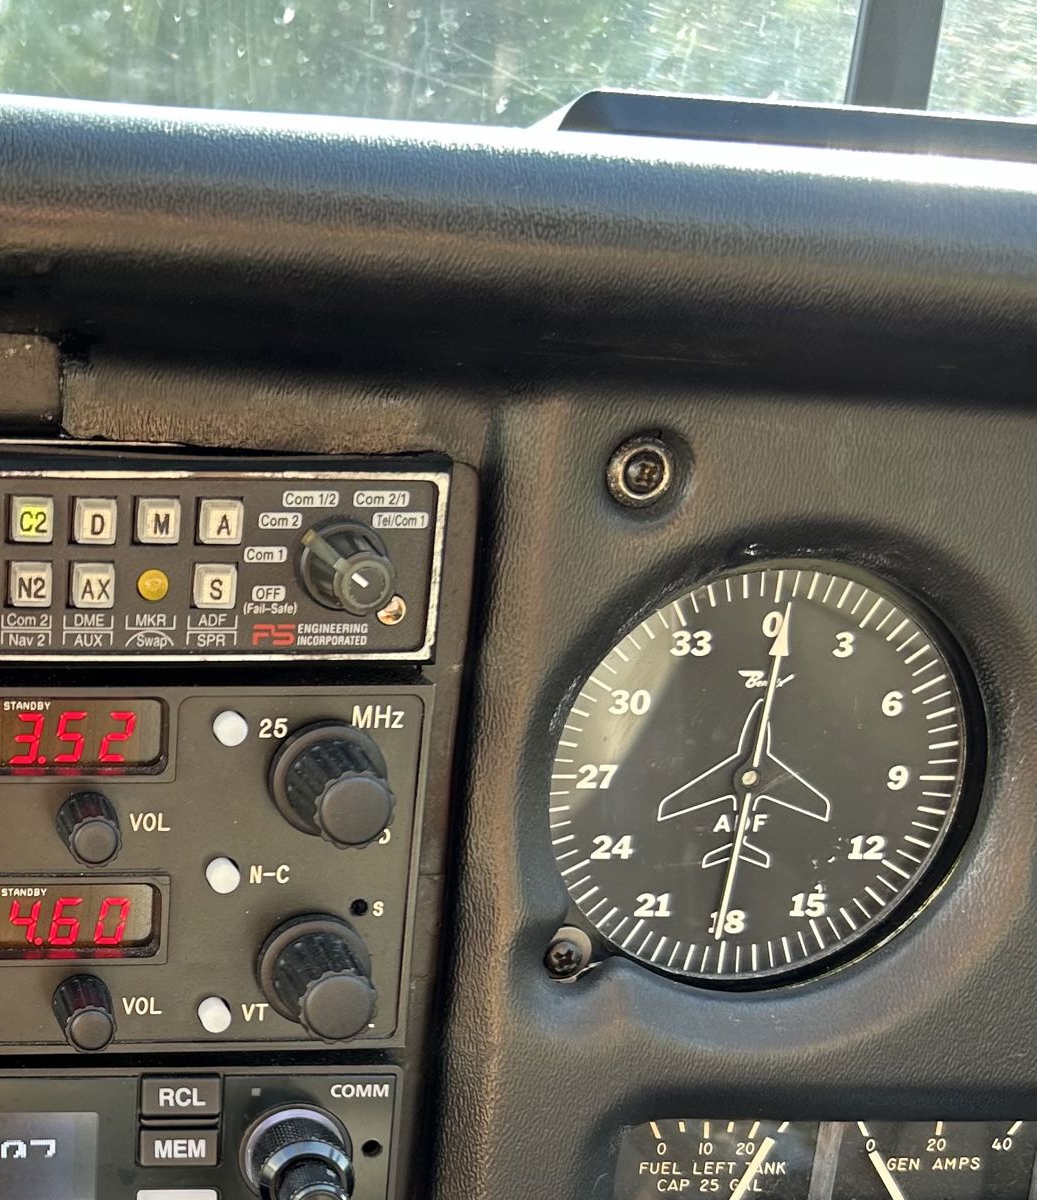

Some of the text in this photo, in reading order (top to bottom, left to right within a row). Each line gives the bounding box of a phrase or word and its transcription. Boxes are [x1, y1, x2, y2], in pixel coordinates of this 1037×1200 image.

[285, 492, 336, 505] Com 1/2
[356, 492, 407, 505] Com 2/1
[255, 588, 281, 600] OFF
[197, 614, 228, 627] ADF
[297, 623, 369, 634] ENGINEERING
[136, 634, 167, 650] Swap
[296, 635, 367, 646] INCORPORATED
[669, 630, 713, 657] 33
[3, 701, 51, 712] STANDBY
[608, 689, 651, 715] 30
[351, 705, 405, 730] MHz
[259, 718, 289, 740] 25
[575, 764, 619, 790] 27
[129, 812, 171, 833] VOL
[590, 835, 634, 860] 24
[847, 835, 887, 860] 12
[0, 887, 48, 898] STANDBY
[633, 893, 671, 918] 21
[789, 892, 827, 918] 15
[122, 997, 163, 1017] VOL
[241, 1003, 269, 1022] VT
[158, 1087, 206, 1107] RCL
[330, 1083, 390, 1098] COMM
[154, 1138, 206, 1159] MEM
[638, 1161, 736, 1175] FUEL LEFT
[886, 1157, 981, 1171] GEN AMPS
[656, 1178, 720, 1192] CAP 25
